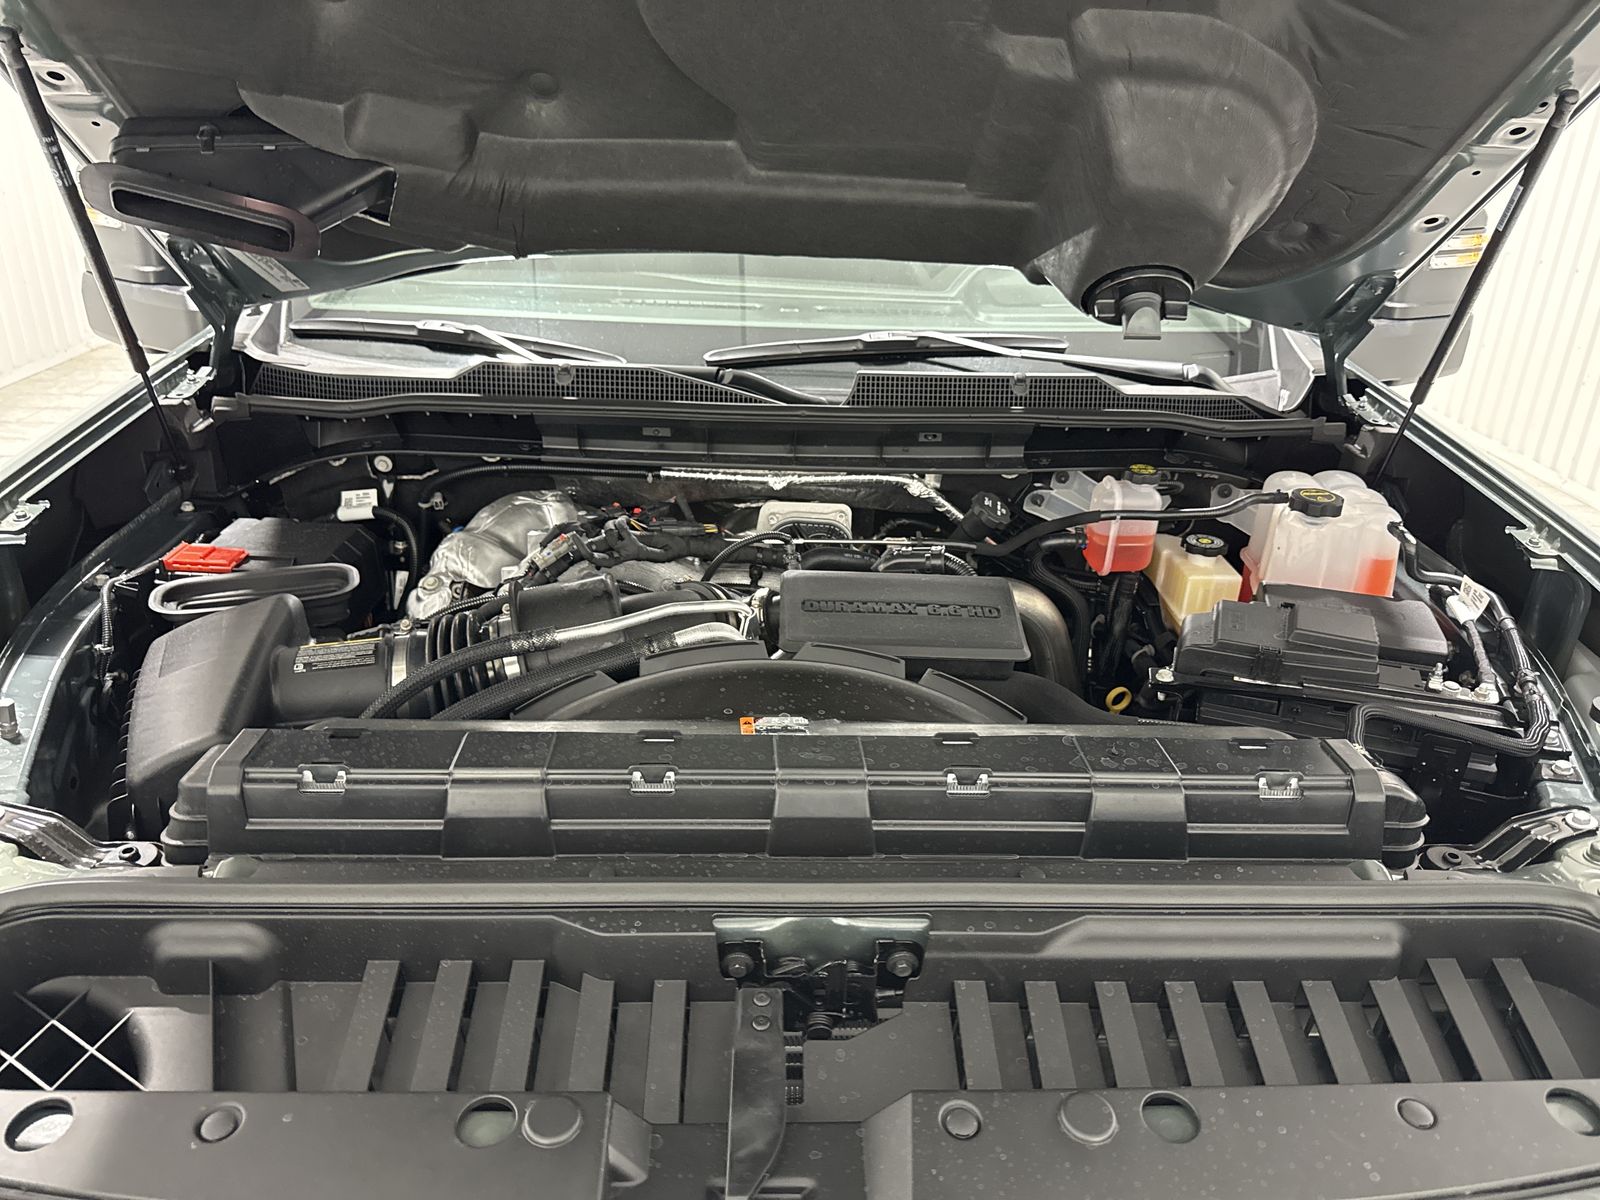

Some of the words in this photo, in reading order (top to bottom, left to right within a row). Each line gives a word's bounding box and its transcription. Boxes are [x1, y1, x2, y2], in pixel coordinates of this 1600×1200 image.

[802, 600, 917, 615] DURAMAX
[927, 604, 962, 617] 6.6
[967, 606, 1001, 618] HD
